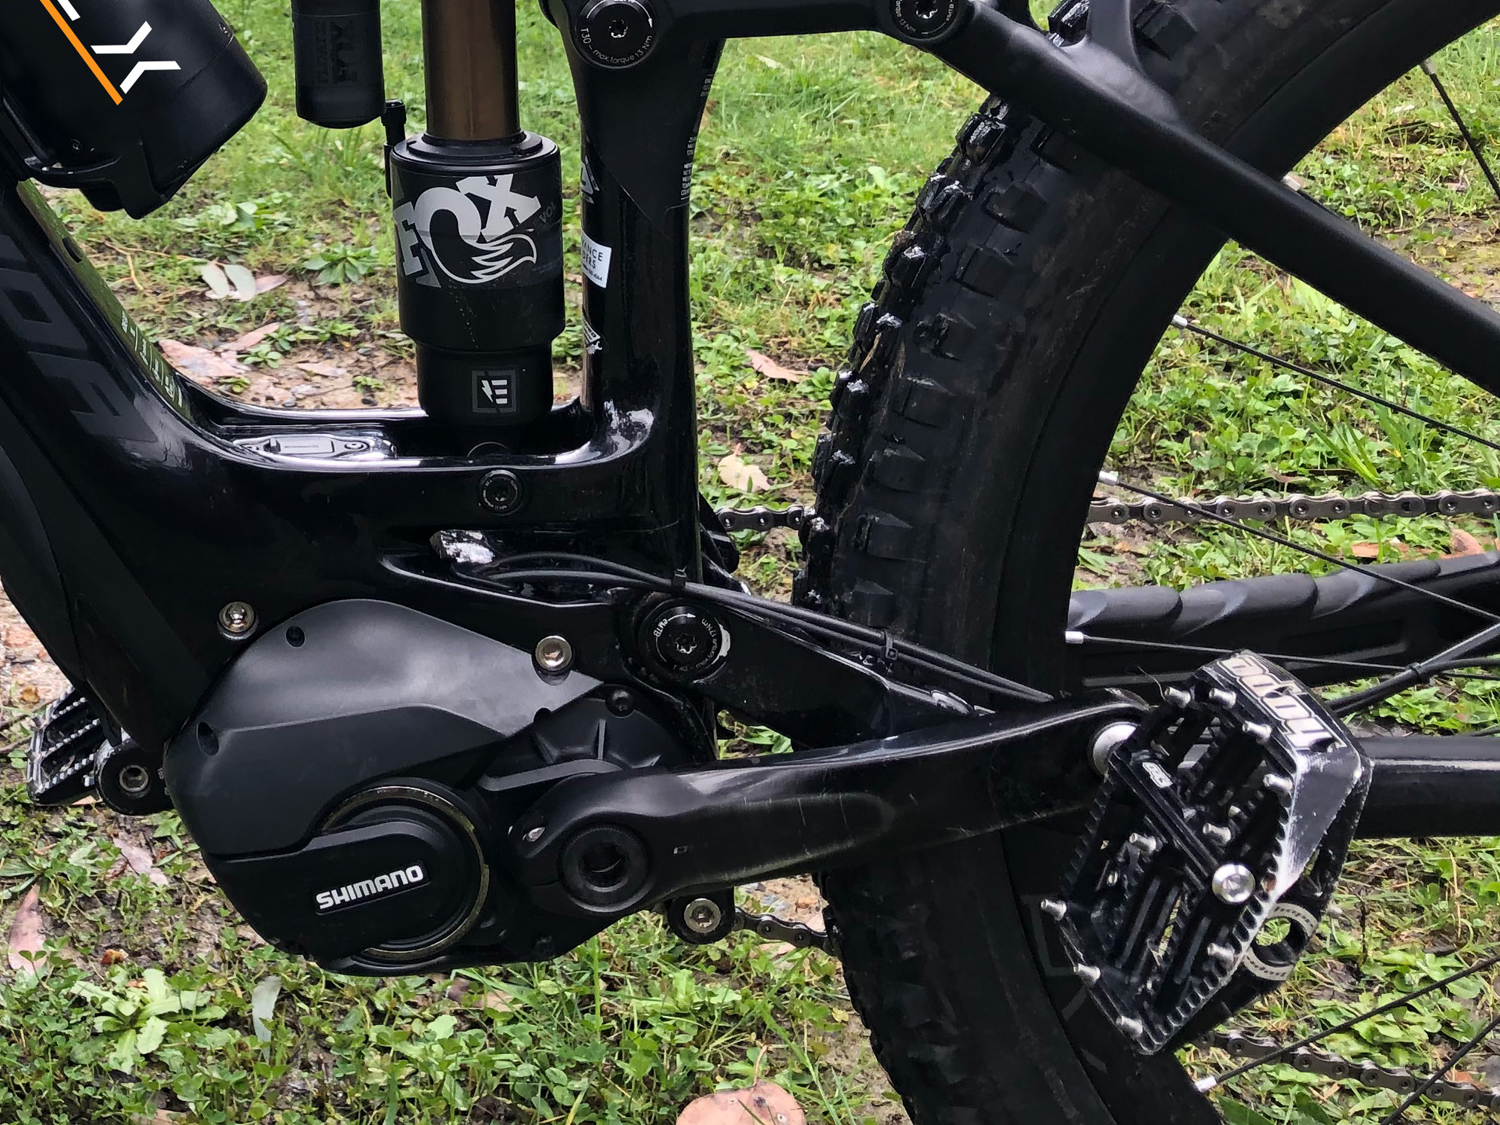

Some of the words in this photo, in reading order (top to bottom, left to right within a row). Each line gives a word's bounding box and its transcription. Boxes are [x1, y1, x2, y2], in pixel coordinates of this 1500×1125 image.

[580, 27, 592, 44] T30
[393, 174, 542, 284] FOX
[1219, 655, 1347, 749] hope
[315, 865, 425, 910] SHIMANO
